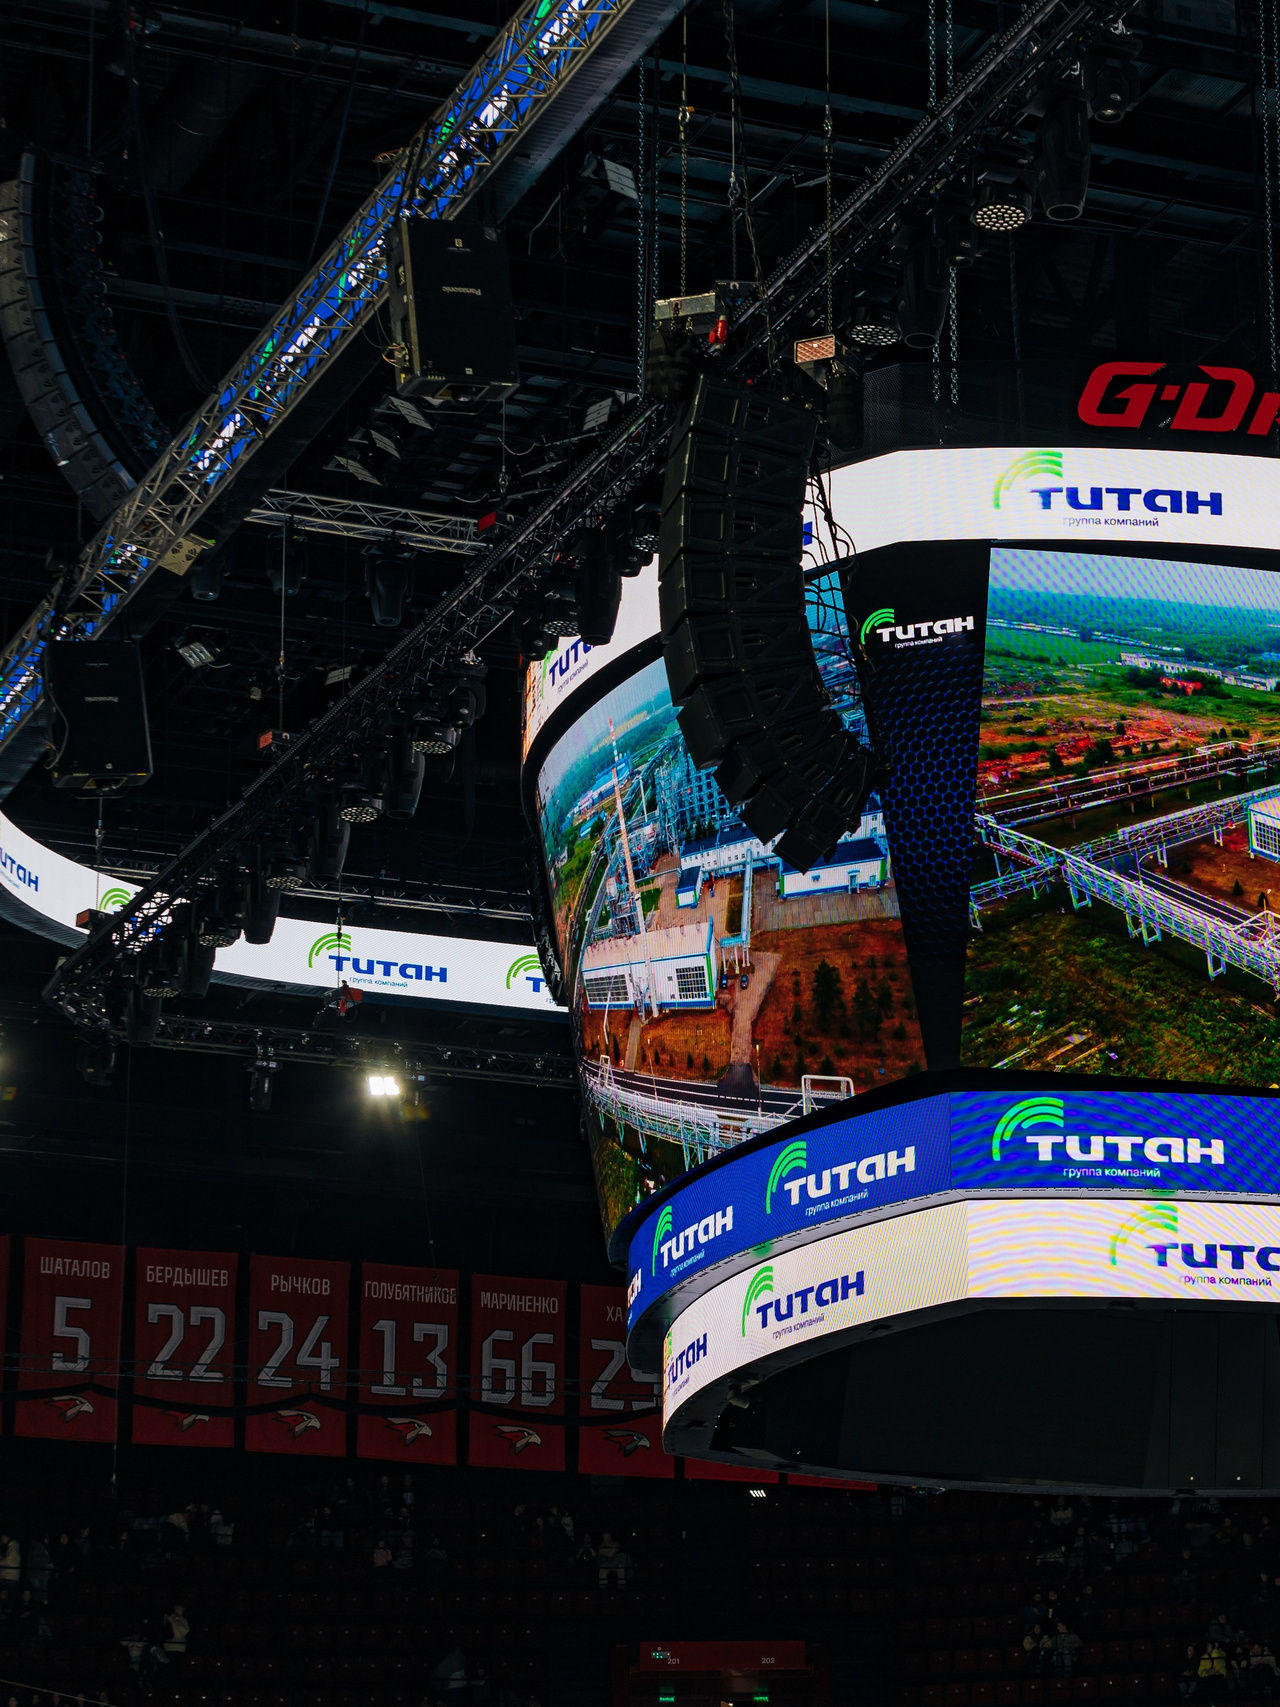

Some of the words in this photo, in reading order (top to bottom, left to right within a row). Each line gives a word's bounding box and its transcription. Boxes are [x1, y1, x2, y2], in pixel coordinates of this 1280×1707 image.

[1063, 517, 1101, 527] группа
[1104, 516, 1159, 527] компаний
[350, 977, 373, 986] группа
[374, 979, 408, 988] компаний
[1063, 1168, 1102, 1177] группа
[1104, 1167, 1161, 1177] компаний
[805, 1201, 830, 1216] группа
[831, 1188, 869, 1207] компаний
[40, 1256, 111, 1279] ШАТАЛОВ
[146, 1265, 229, 1288] БЕРДЫШЕВ
[271, 1274, 331, 1295] РЫЧКОВ
[365, 1280, 457, 1305] ГОЛУБЯТНИКОВ
[480, 1291, 559, 1314] МАРИНЕНКО
[51, 1295, 91, 1372] 5
[772, 1325, 792, 1340] группа
[793, 1313, 825, 1332] компаний
[146, 1303, 226, 1383] 22
[257, 1310, 340, 1391] 24
[370, 1319, 449, 1398] 13
[481, 1329, 556, 1407] 66
